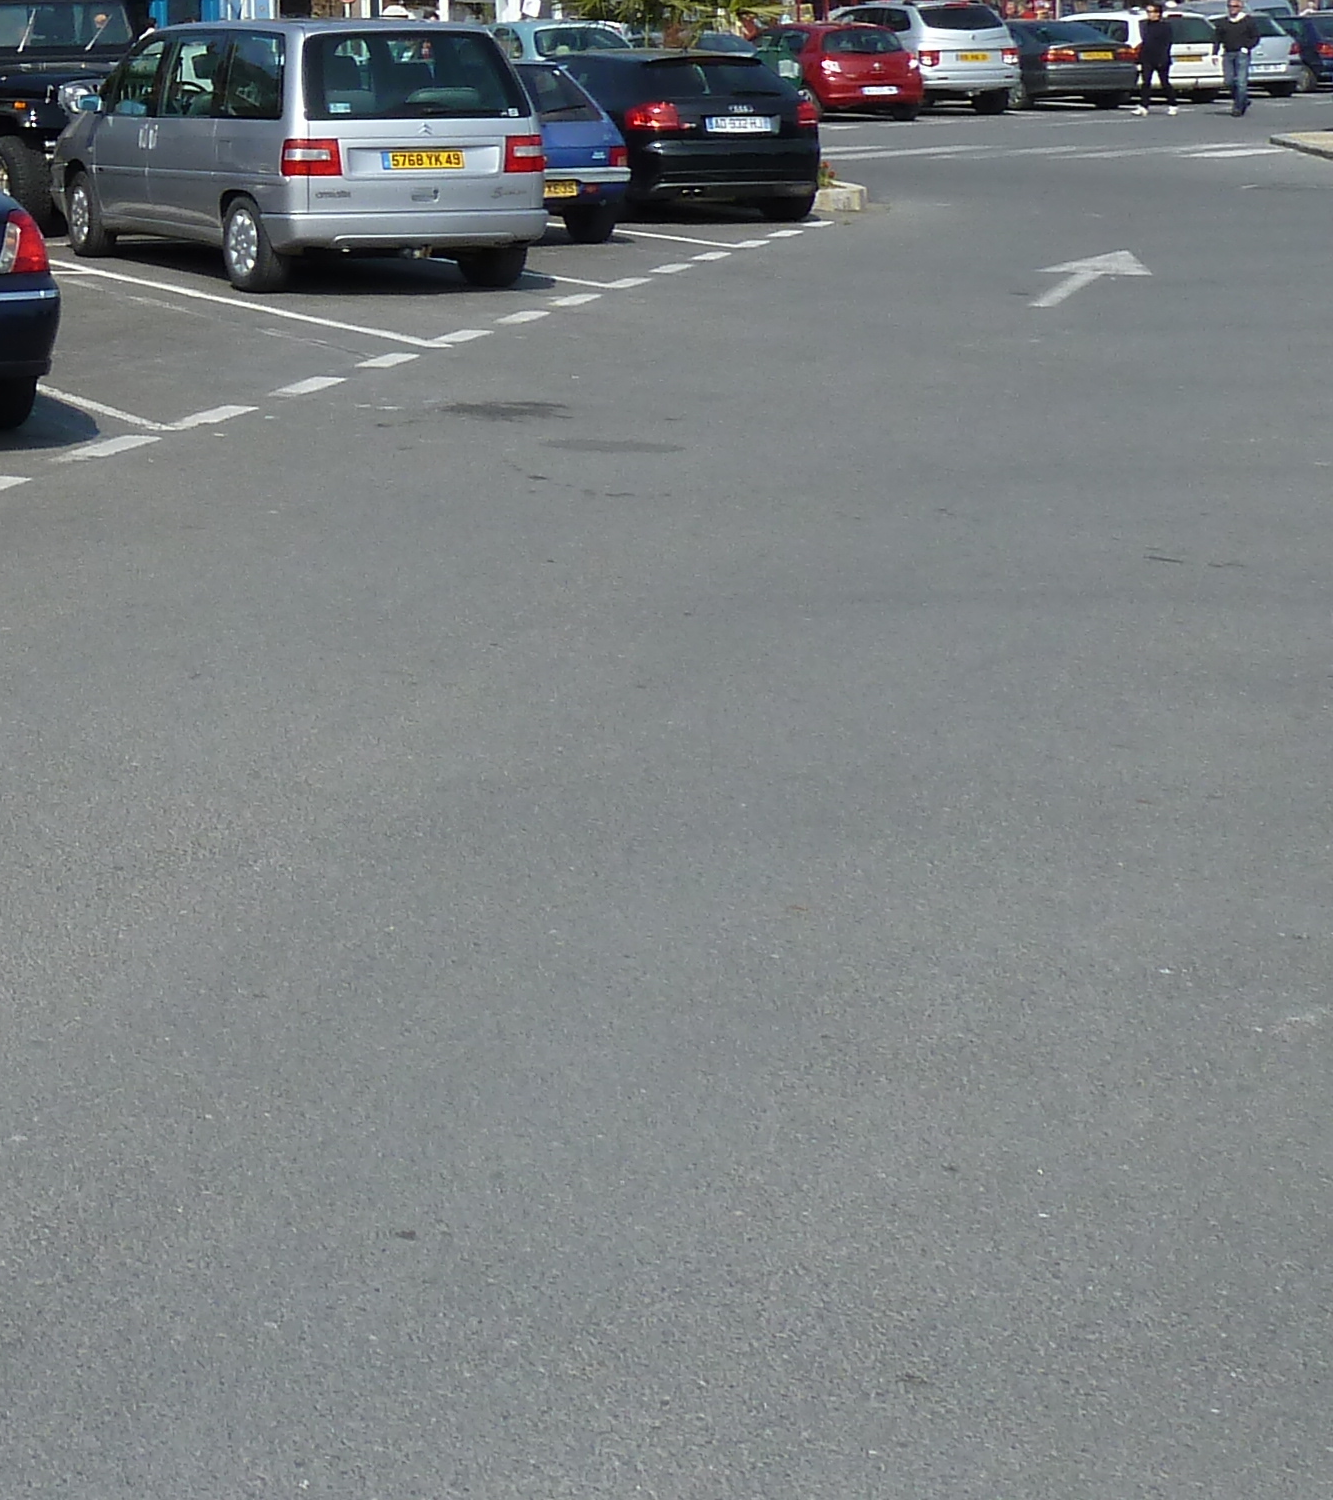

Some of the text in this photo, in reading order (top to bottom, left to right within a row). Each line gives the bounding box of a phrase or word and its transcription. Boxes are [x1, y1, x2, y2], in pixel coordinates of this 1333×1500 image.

[392, 151, 460, 167] 5768 YK 49
